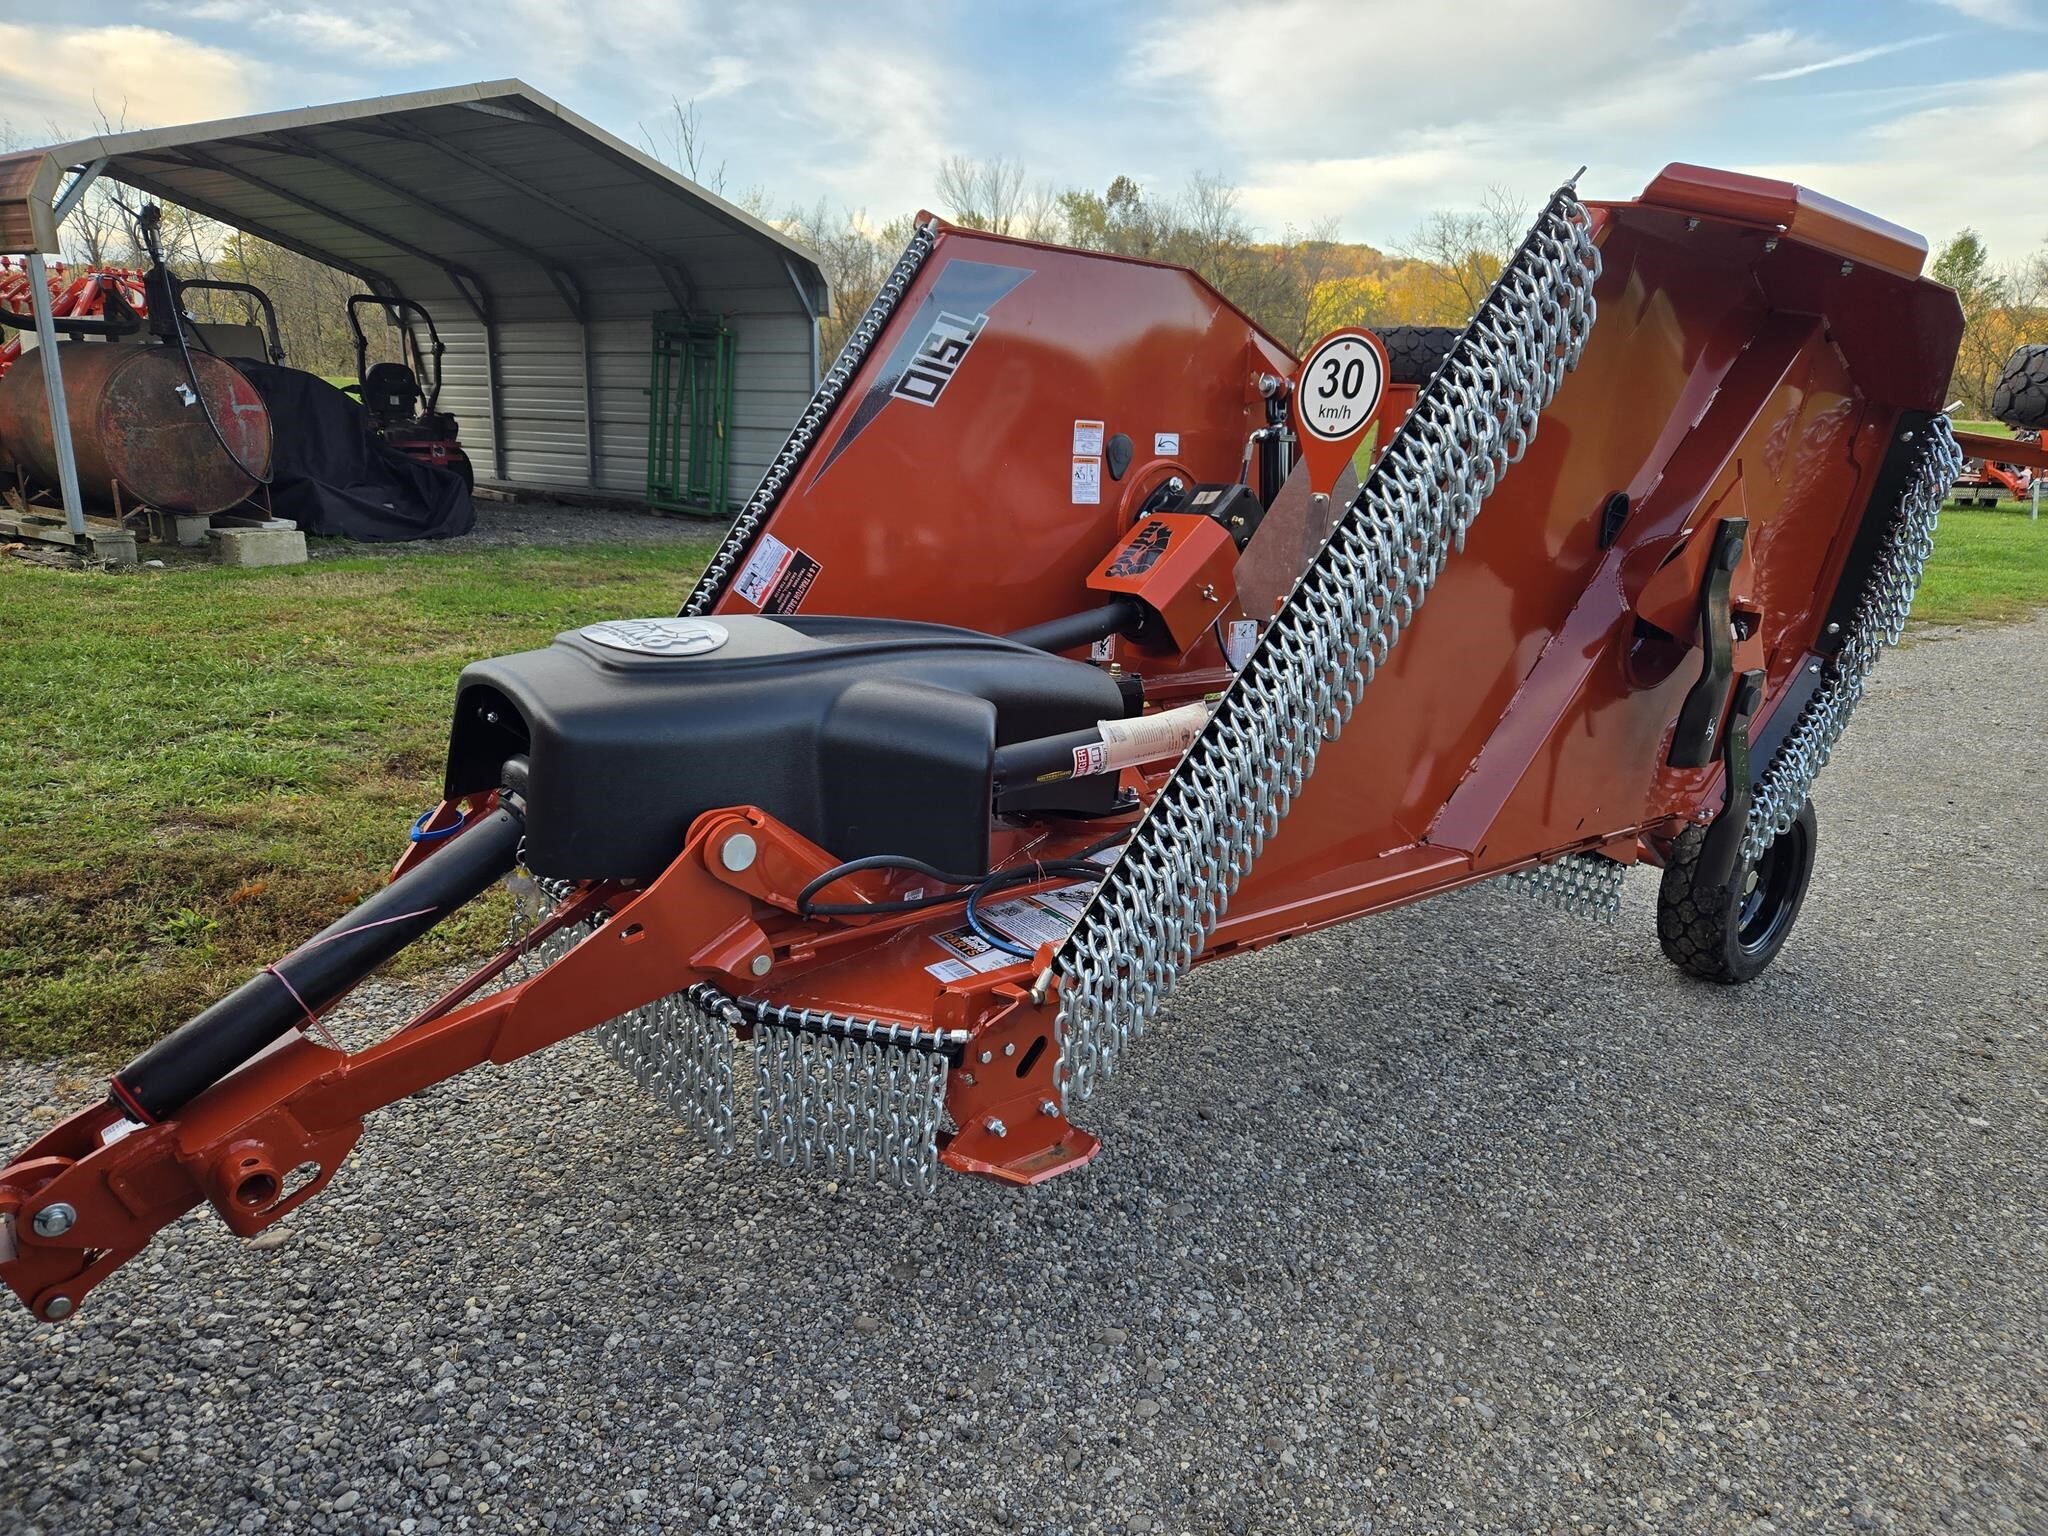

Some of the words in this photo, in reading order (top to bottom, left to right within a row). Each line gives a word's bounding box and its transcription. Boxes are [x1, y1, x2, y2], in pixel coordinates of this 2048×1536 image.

[1318, 358, 1364, 399] 30
[1318, 404, 1352, 419] km/h
[793, 576, 811, 601] TRACTOR
[943, 933, 979, 957] PARTS
